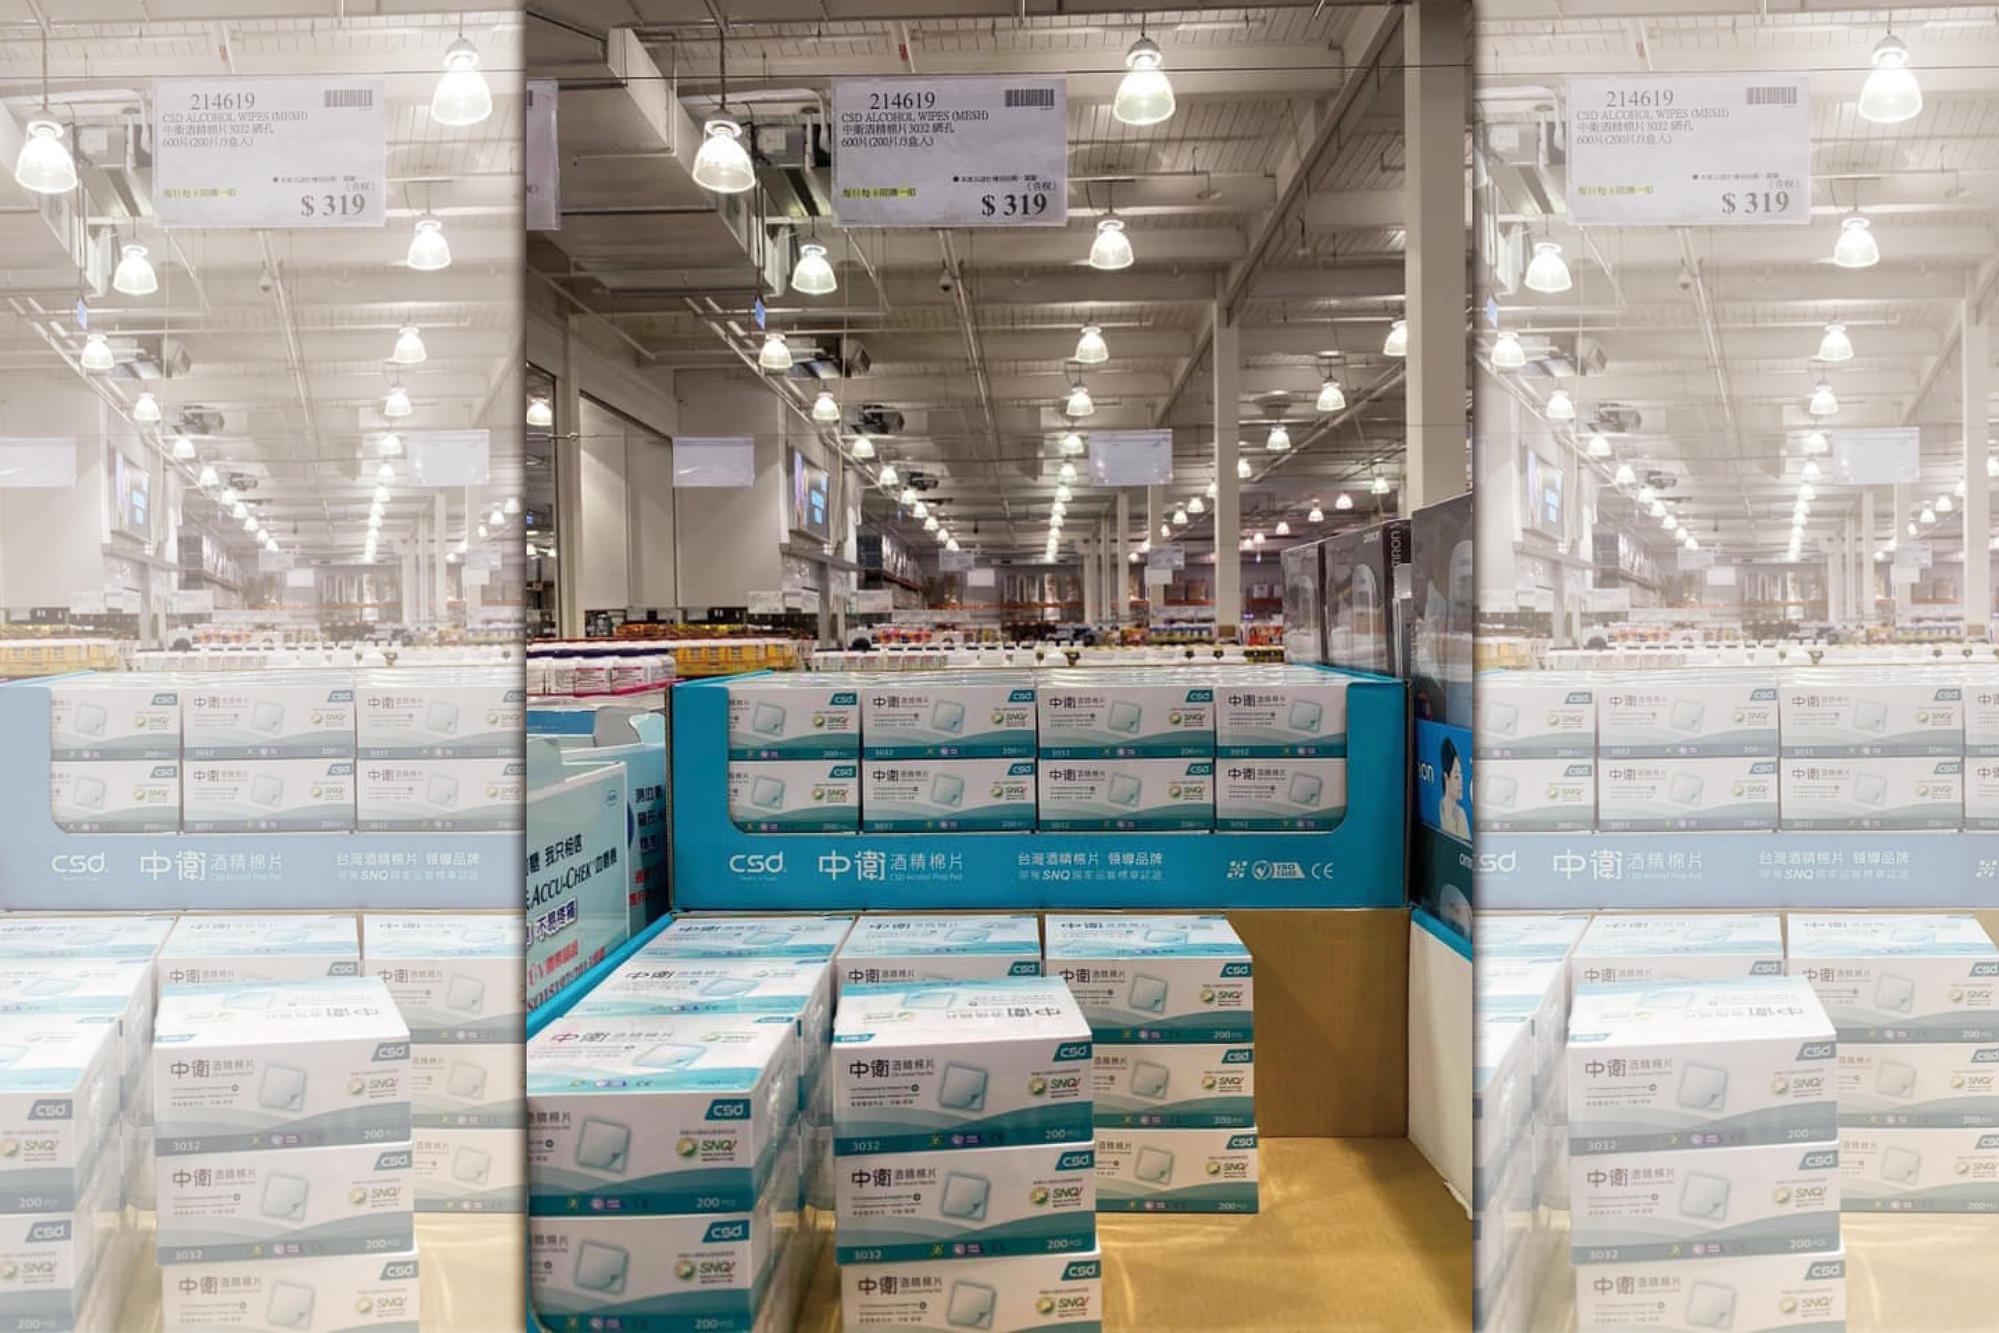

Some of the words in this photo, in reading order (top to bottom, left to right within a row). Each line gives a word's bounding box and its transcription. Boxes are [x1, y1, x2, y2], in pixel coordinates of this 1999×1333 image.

[190, 92, 256, 110] 214619
[870, 92, 936, 110] 214619
[1606, 89, 1675, 107] 214619
[186, 113, 235, 122] ALCOHOL
[238, 112, 270, 122] WIPES
[866, 112, 915, 122] ALCOHOL
[918, 112, 950, 122] WIPES
[952, 110, 988, 122] (MESH)
[1601, 110, 1653, 120] ALCOHOL
[1656, 109, 1689, 119] WIPES
[1003, 194, 1048, 216] 319
[52, 851, 105, 873] csd
[730, 851, 784, 873] csd
[1013, 964, 1035, 972] csd
[1060, 1045, 1088, 1057] csd
[713, 1104, 744, 1116] csd
[1046, 1130, 1066, 1140] 200
[852, 1141, 880, 1152] 3032
[1062, 1154, 1089, 1166] csd
[696, 1198, 720, 1208] 200
[712, 1226, 742, 1238] csd
[1047, 1238, 1068, 1249] 200
[854, 1250, 881, 1260] 3032
[1069, 1264, 1096, 1276] csd
[694, 1319, 718, 1329] 200
